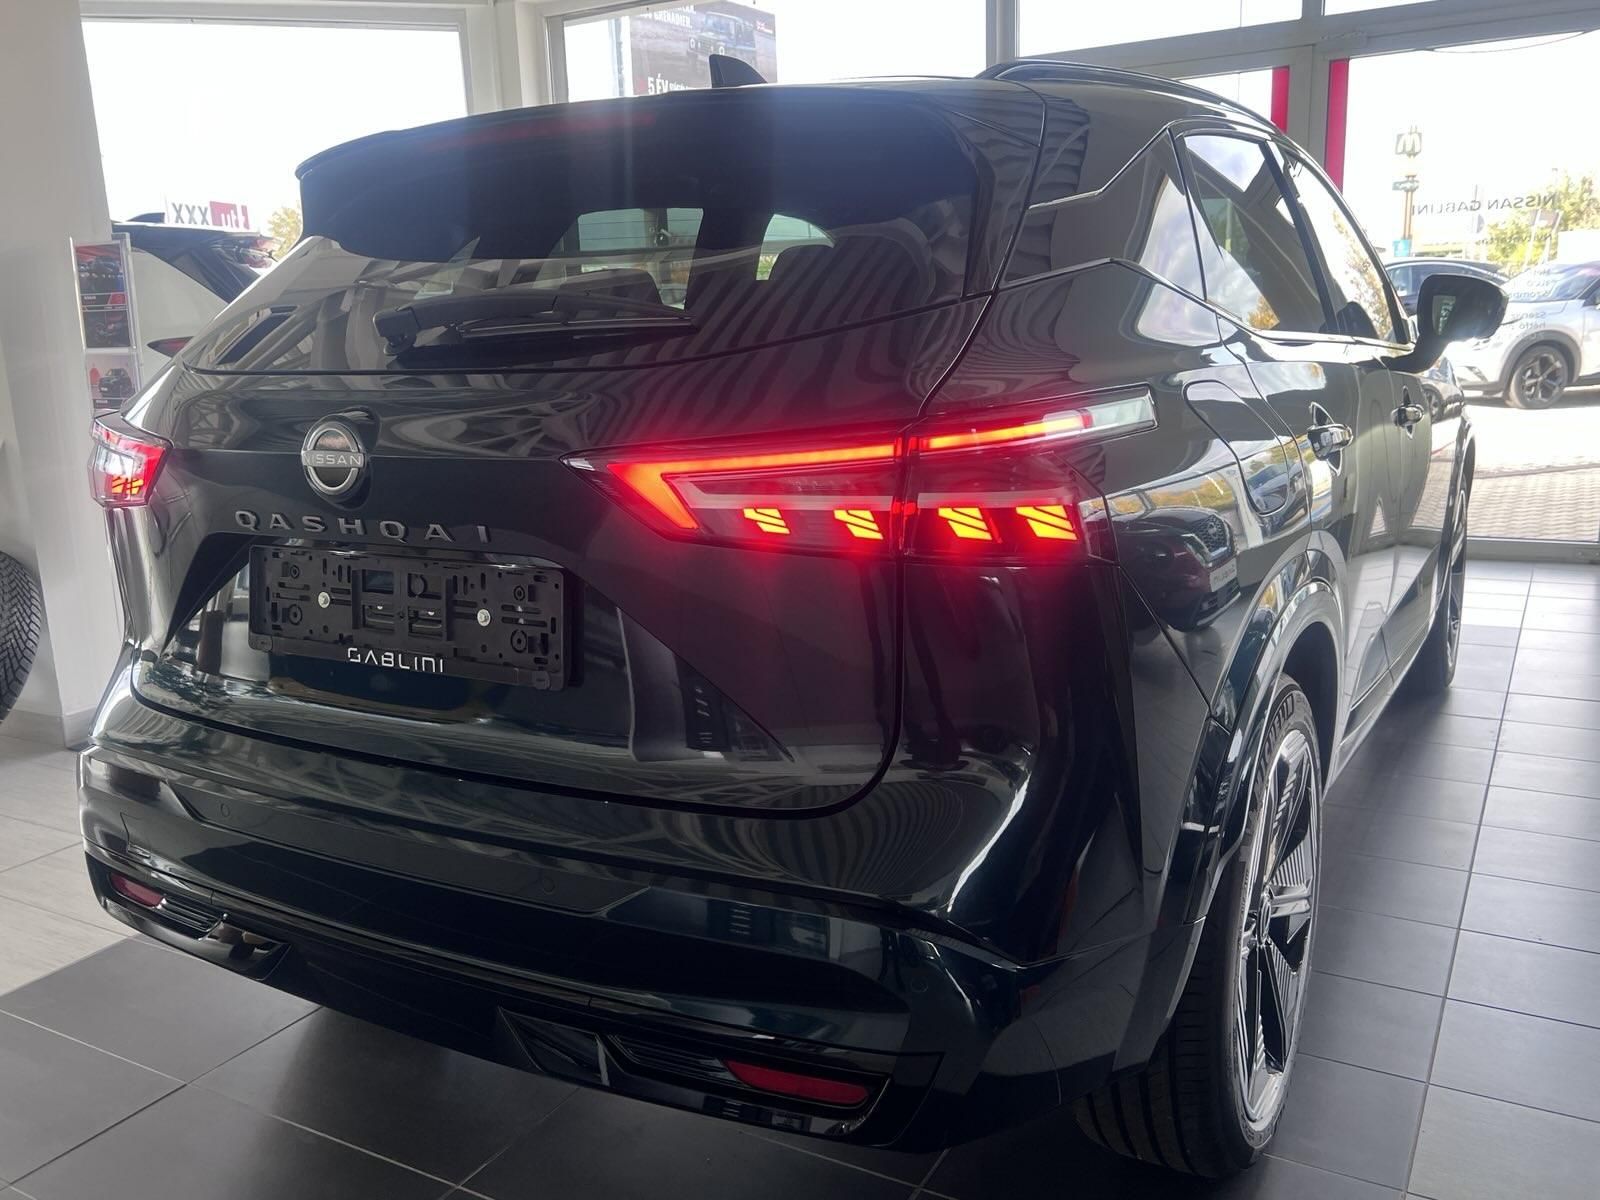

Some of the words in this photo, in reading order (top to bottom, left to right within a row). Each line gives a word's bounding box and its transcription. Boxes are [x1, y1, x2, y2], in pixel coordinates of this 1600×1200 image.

[647, 76, 655, 95] 5
[302, 453, 364, 466] NISSAN
[234, 510, 492, 543] QASHQAI
[347, 647, 444, 673] GABLINI
